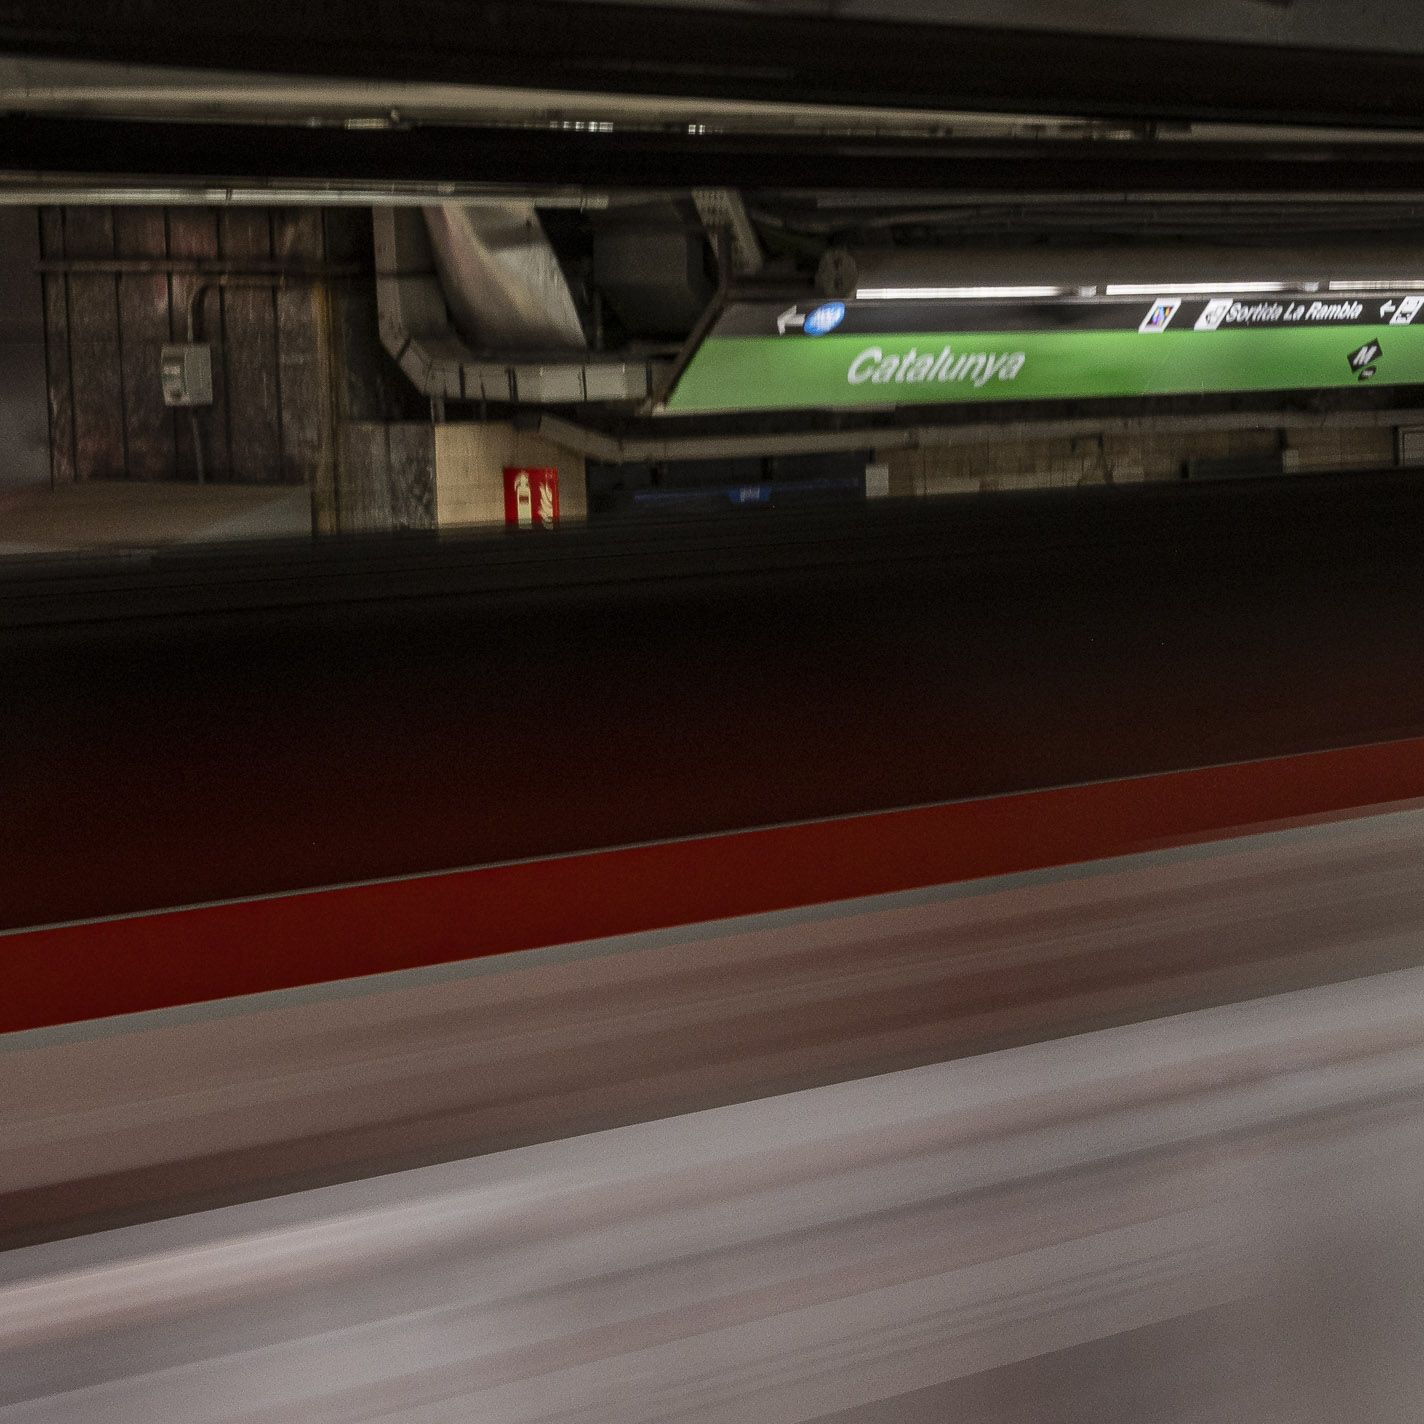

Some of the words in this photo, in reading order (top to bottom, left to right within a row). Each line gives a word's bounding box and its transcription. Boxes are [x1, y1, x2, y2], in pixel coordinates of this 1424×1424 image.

[1226, 301, 1284, 323] Sortida
[1282, 301, 1306, 321] La
[1304, 300, 1364, 321] Rambla
[847, 344, 1026, 389] Catalunya
